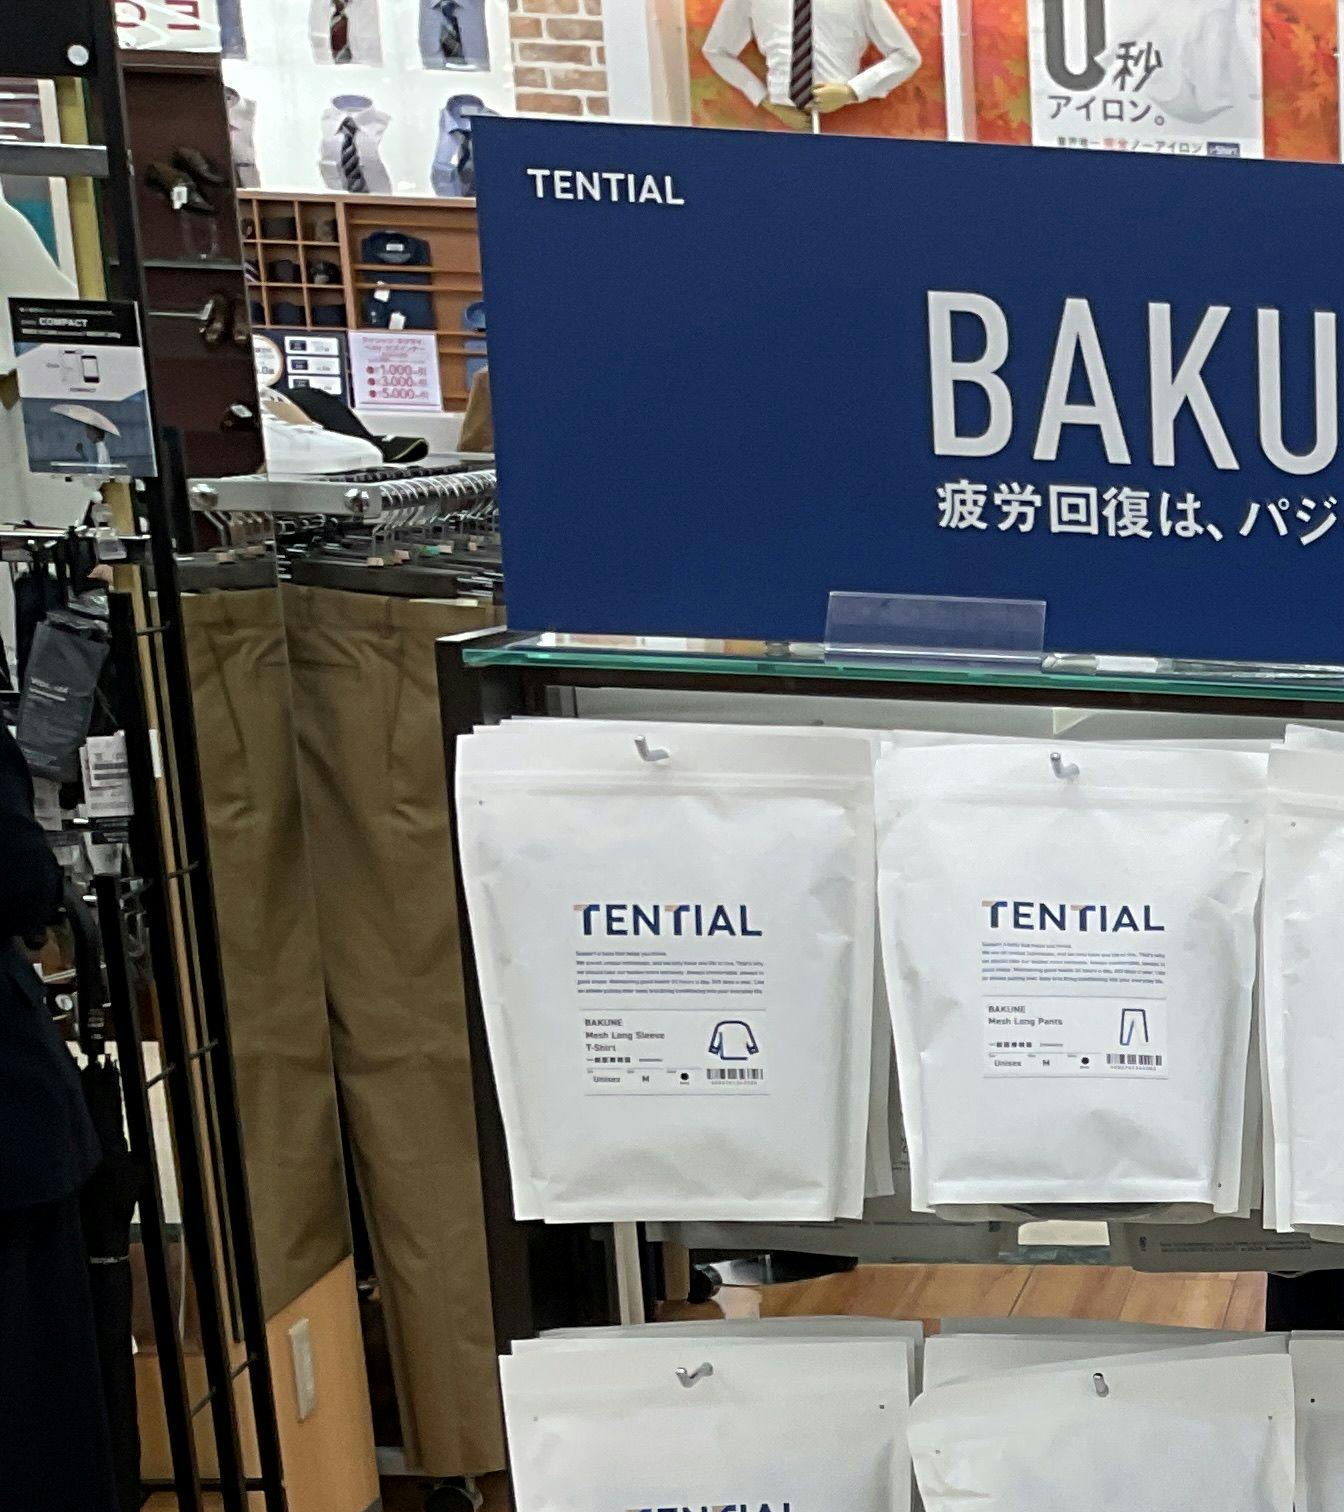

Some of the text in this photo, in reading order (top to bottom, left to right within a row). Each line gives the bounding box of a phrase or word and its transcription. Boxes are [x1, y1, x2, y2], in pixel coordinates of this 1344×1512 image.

[1048, 95, 1165, 126] アイロン。
[527, 168, 685, 205] TENTIAL
[574, 904, 762, 936] TENTIAL
[982, 901, 1165, 931] TENTIAL
[612, 1032, 633, 1041] Long
[1014, 1018, 1035, 1026] Long
[1038, 1018, 1063, 1026] Pants
[586, 1044, 616, 1052] T-Shirt
